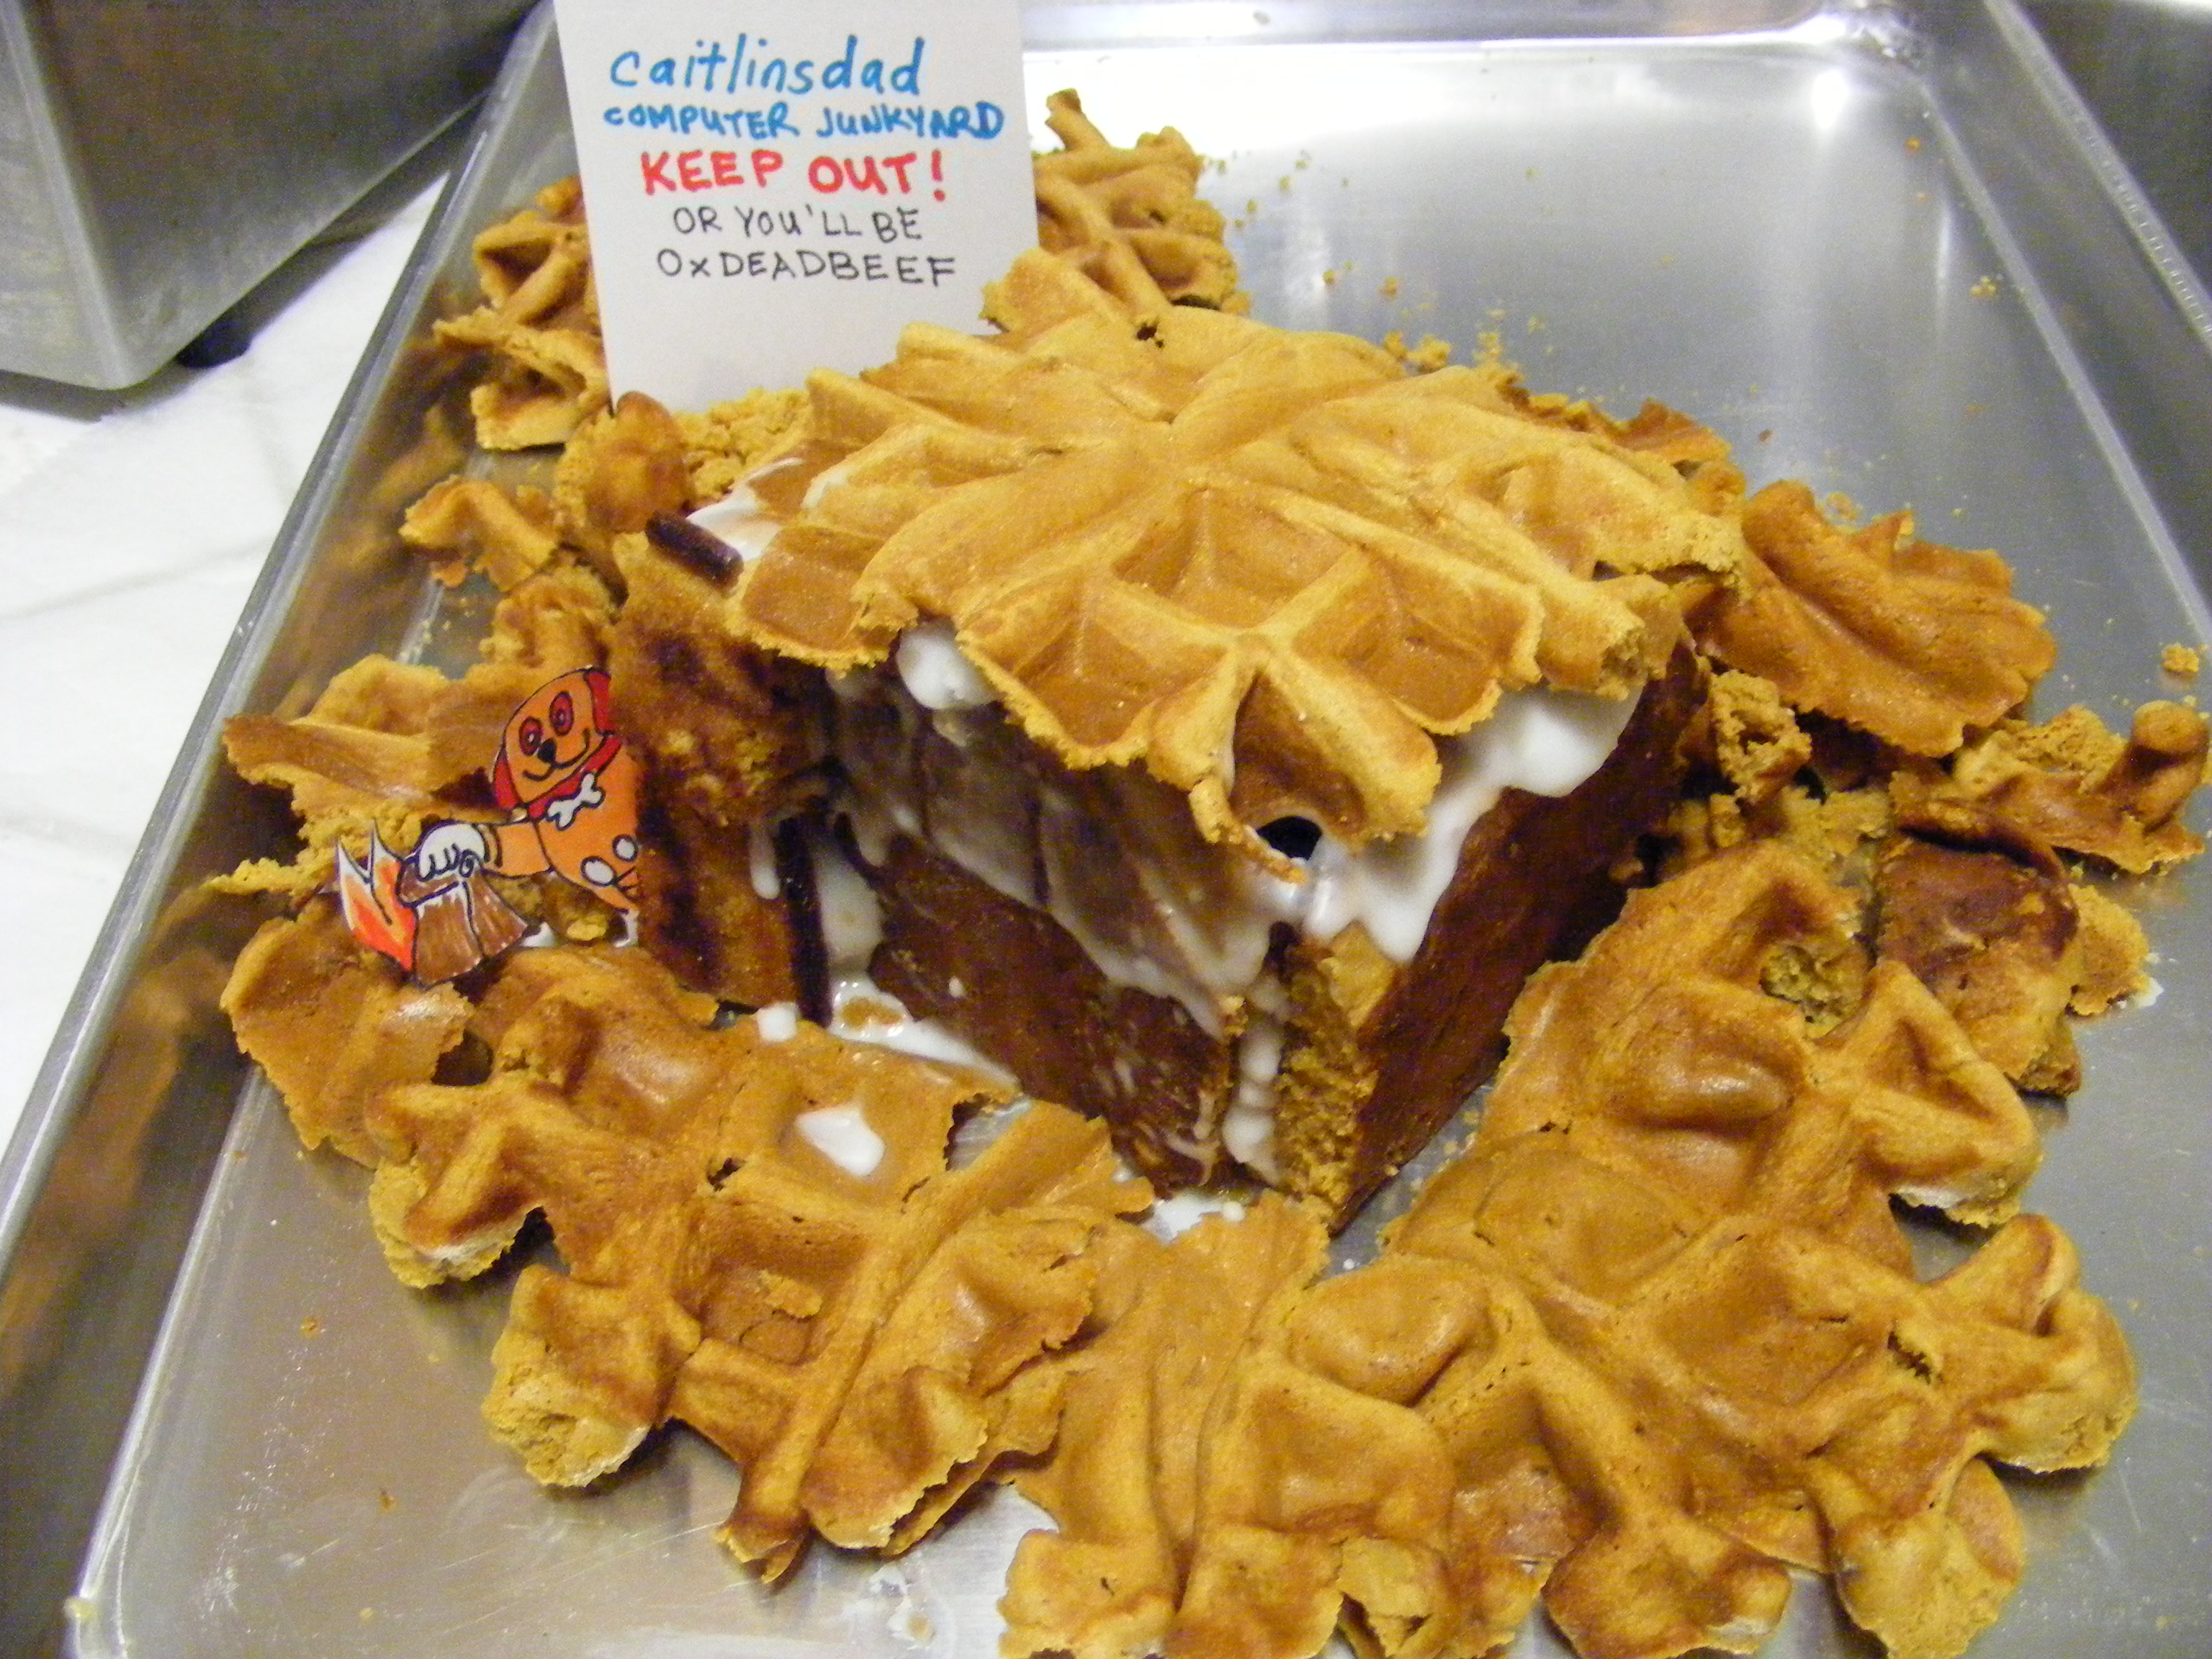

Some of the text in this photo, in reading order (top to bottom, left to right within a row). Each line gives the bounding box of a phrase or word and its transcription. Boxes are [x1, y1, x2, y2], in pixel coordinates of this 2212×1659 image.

[815, 101, 1006, 141] JUNKYARD
[640, 149, 946, 202] KEEP OUT!
[673, 204, 923, 244] OR YOU'LL BE
